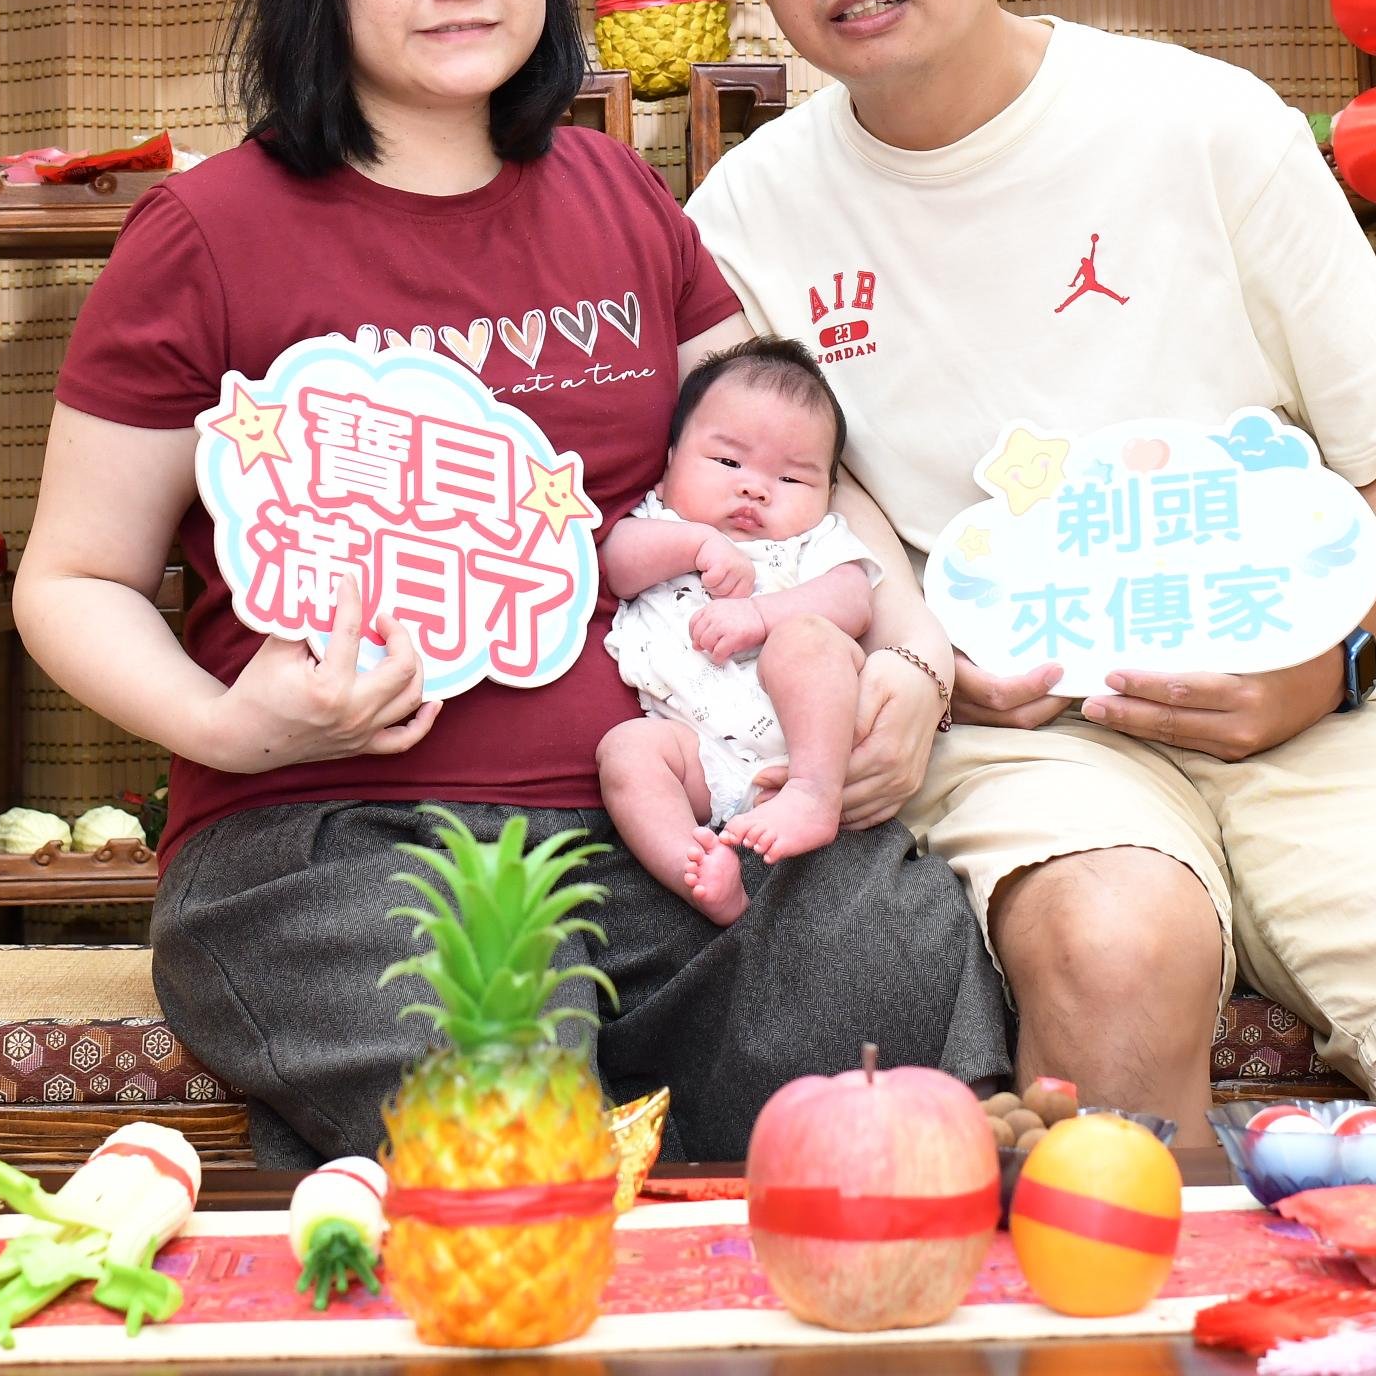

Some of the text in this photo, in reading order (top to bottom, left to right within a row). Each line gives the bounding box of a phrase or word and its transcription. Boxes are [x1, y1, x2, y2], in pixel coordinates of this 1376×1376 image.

[809, 271, 876, 325] AIR
[816, 342, 876, 364] JORDAN
[835, 324, 851, 344] 23
[512, 374, 554, 394] at
[560, 378, 586, 389] a
[584, 362, 656, 385] time
[299, 388, 521, 547] 寶貝
[1056, 468, 1242, 557] 剃頭
[247, 500, 573, 673] 滿月了
[1009, 566, 1293, 659] 來傳家
